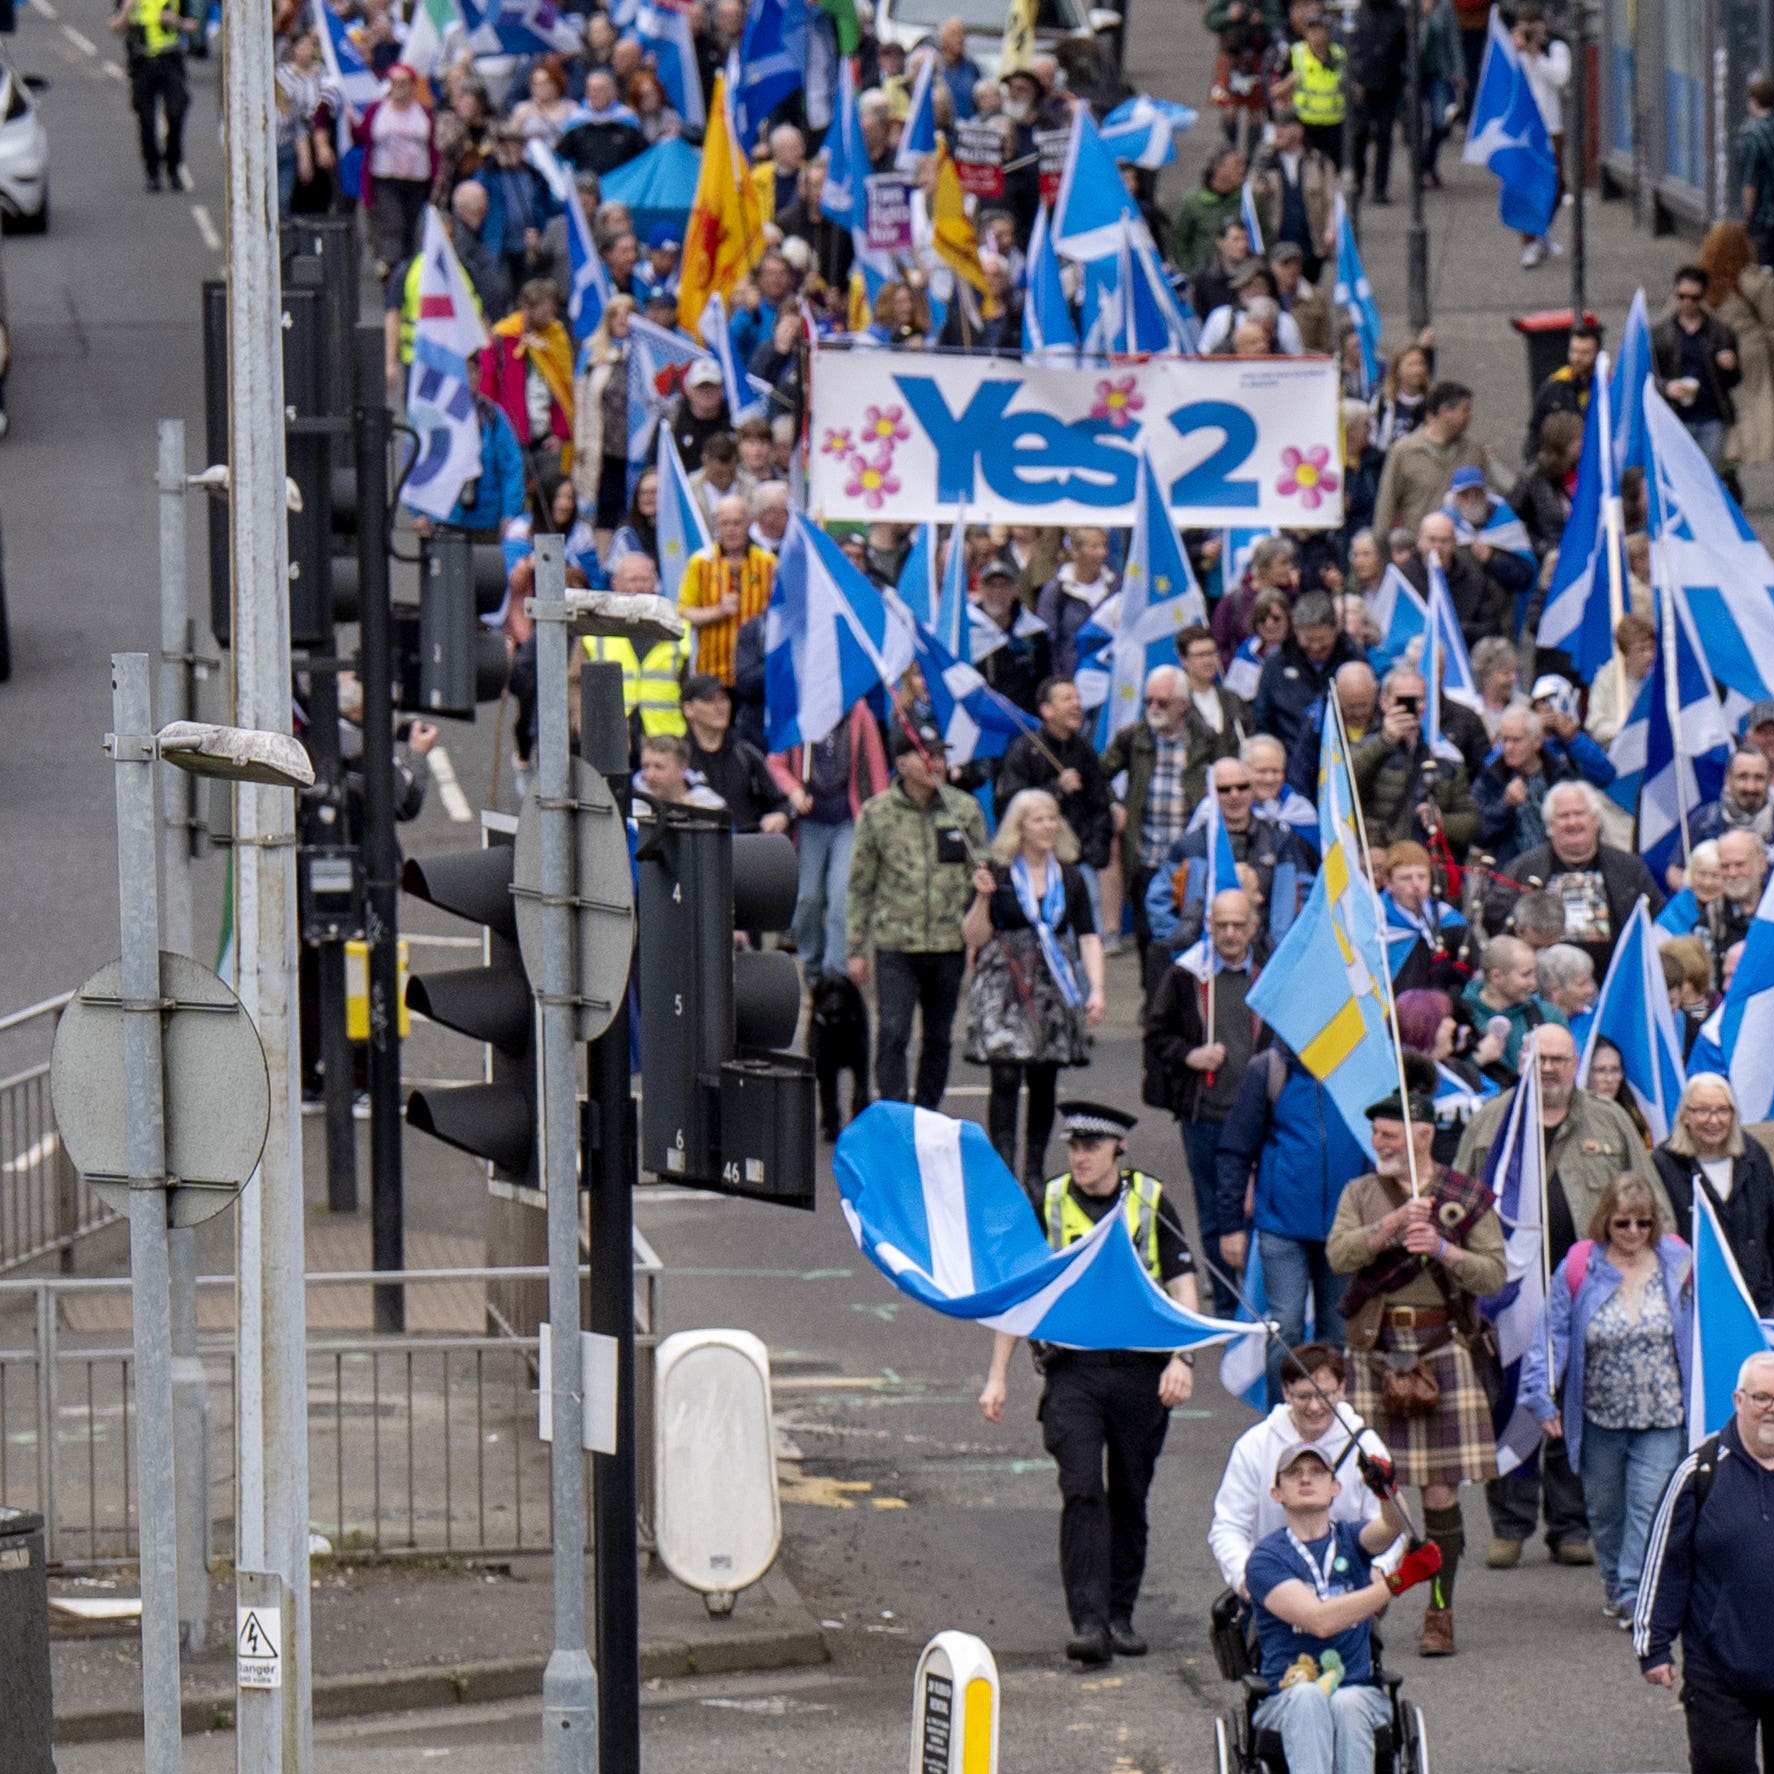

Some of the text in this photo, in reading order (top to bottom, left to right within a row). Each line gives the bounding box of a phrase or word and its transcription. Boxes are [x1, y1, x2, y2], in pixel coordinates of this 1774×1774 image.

[894, 376, 1258, 508] Yes 2
[672, 882, 682, 903] 4
[674, 994, 682, 1015] 5
[676, 1129, 684, 1149] 6
[723, 1161, 740, 1183] 46
